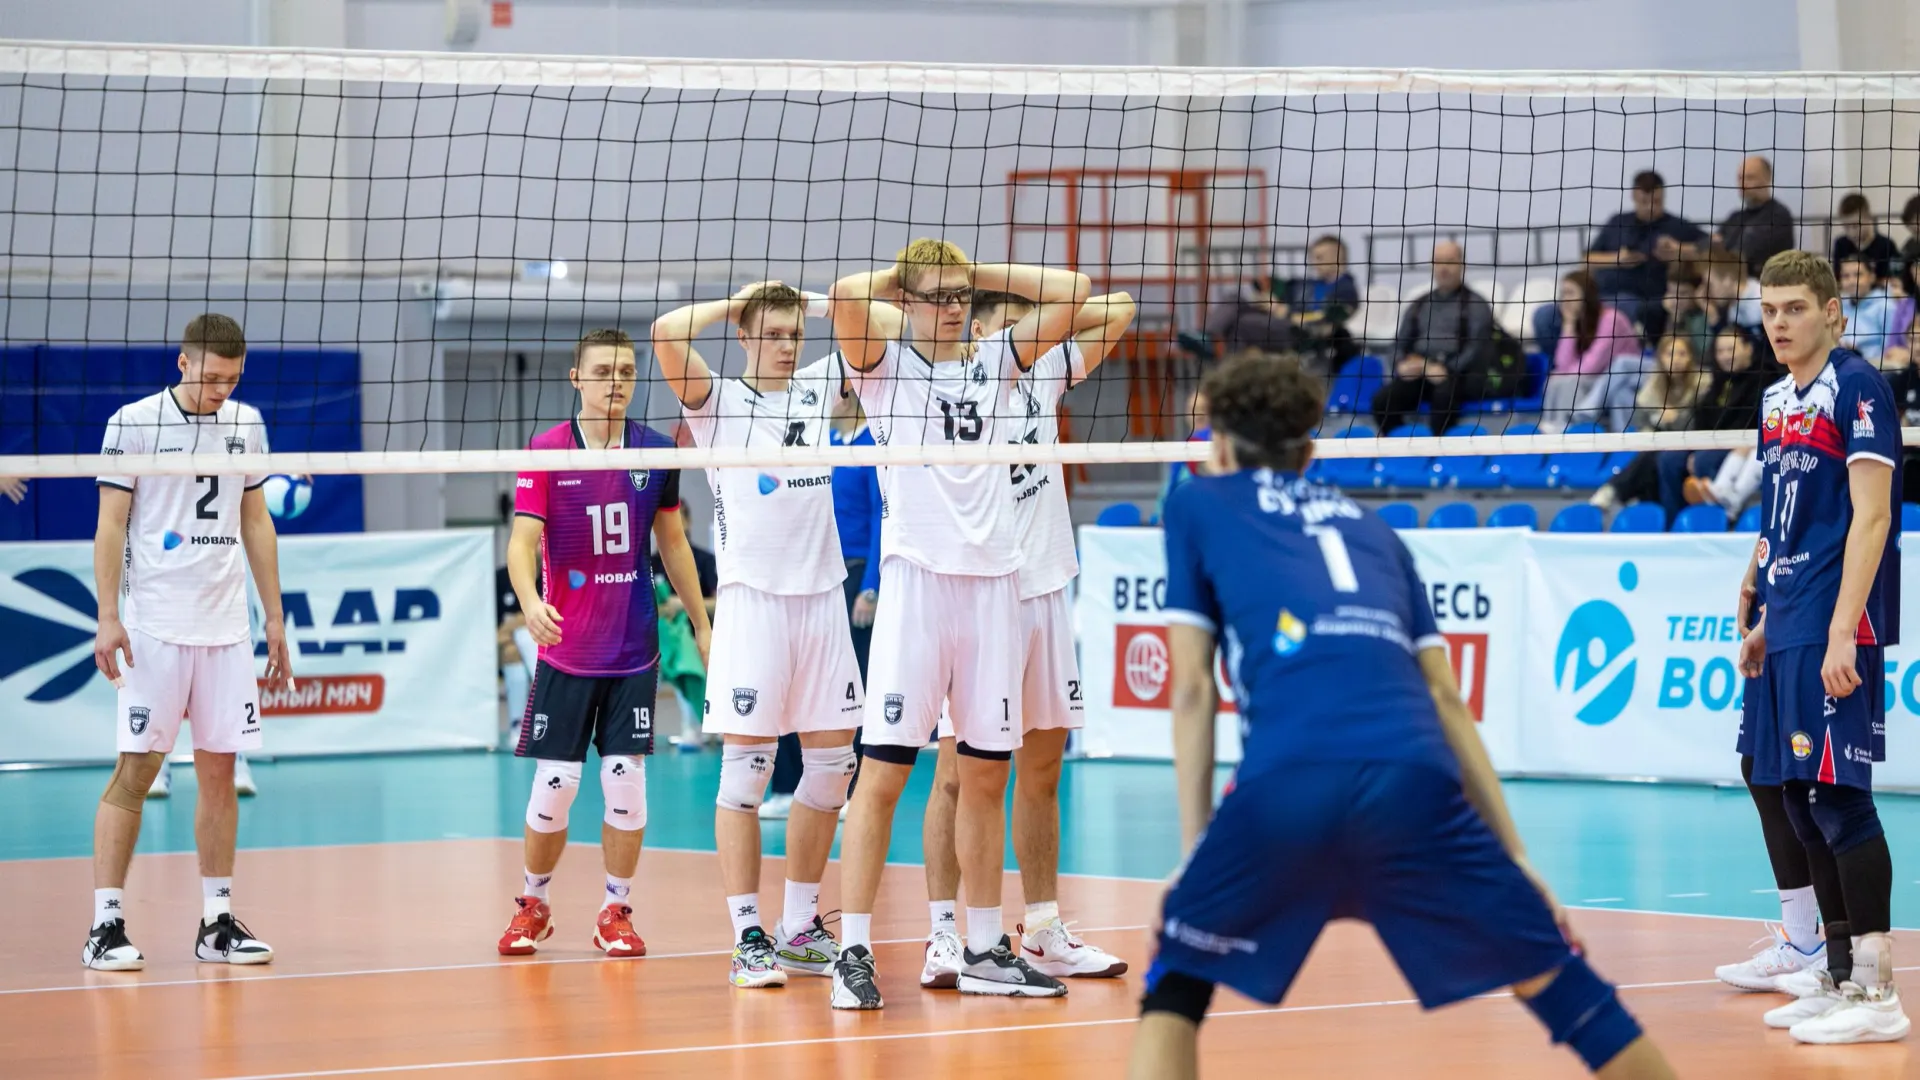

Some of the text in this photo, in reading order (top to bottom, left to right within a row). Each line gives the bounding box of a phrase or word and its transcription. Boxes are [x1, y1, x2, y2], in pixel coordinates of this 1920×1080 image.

[936, 396, 984, 441] 13
[195, 475, 219, 521] 2
[585, 501, 631, 556] 19
[1302, 524, 1360, 593] 1
[1423, 582, 1491, 621] ЕСЬ
[1666, 616, 1742, 641] ТЕЛЕ
[845, 681, 856, 702] 4
[1657, 656, 1744, 712] ВО
[244, 702, 257, 725] 2
[632, 707, 651, 730] 19
